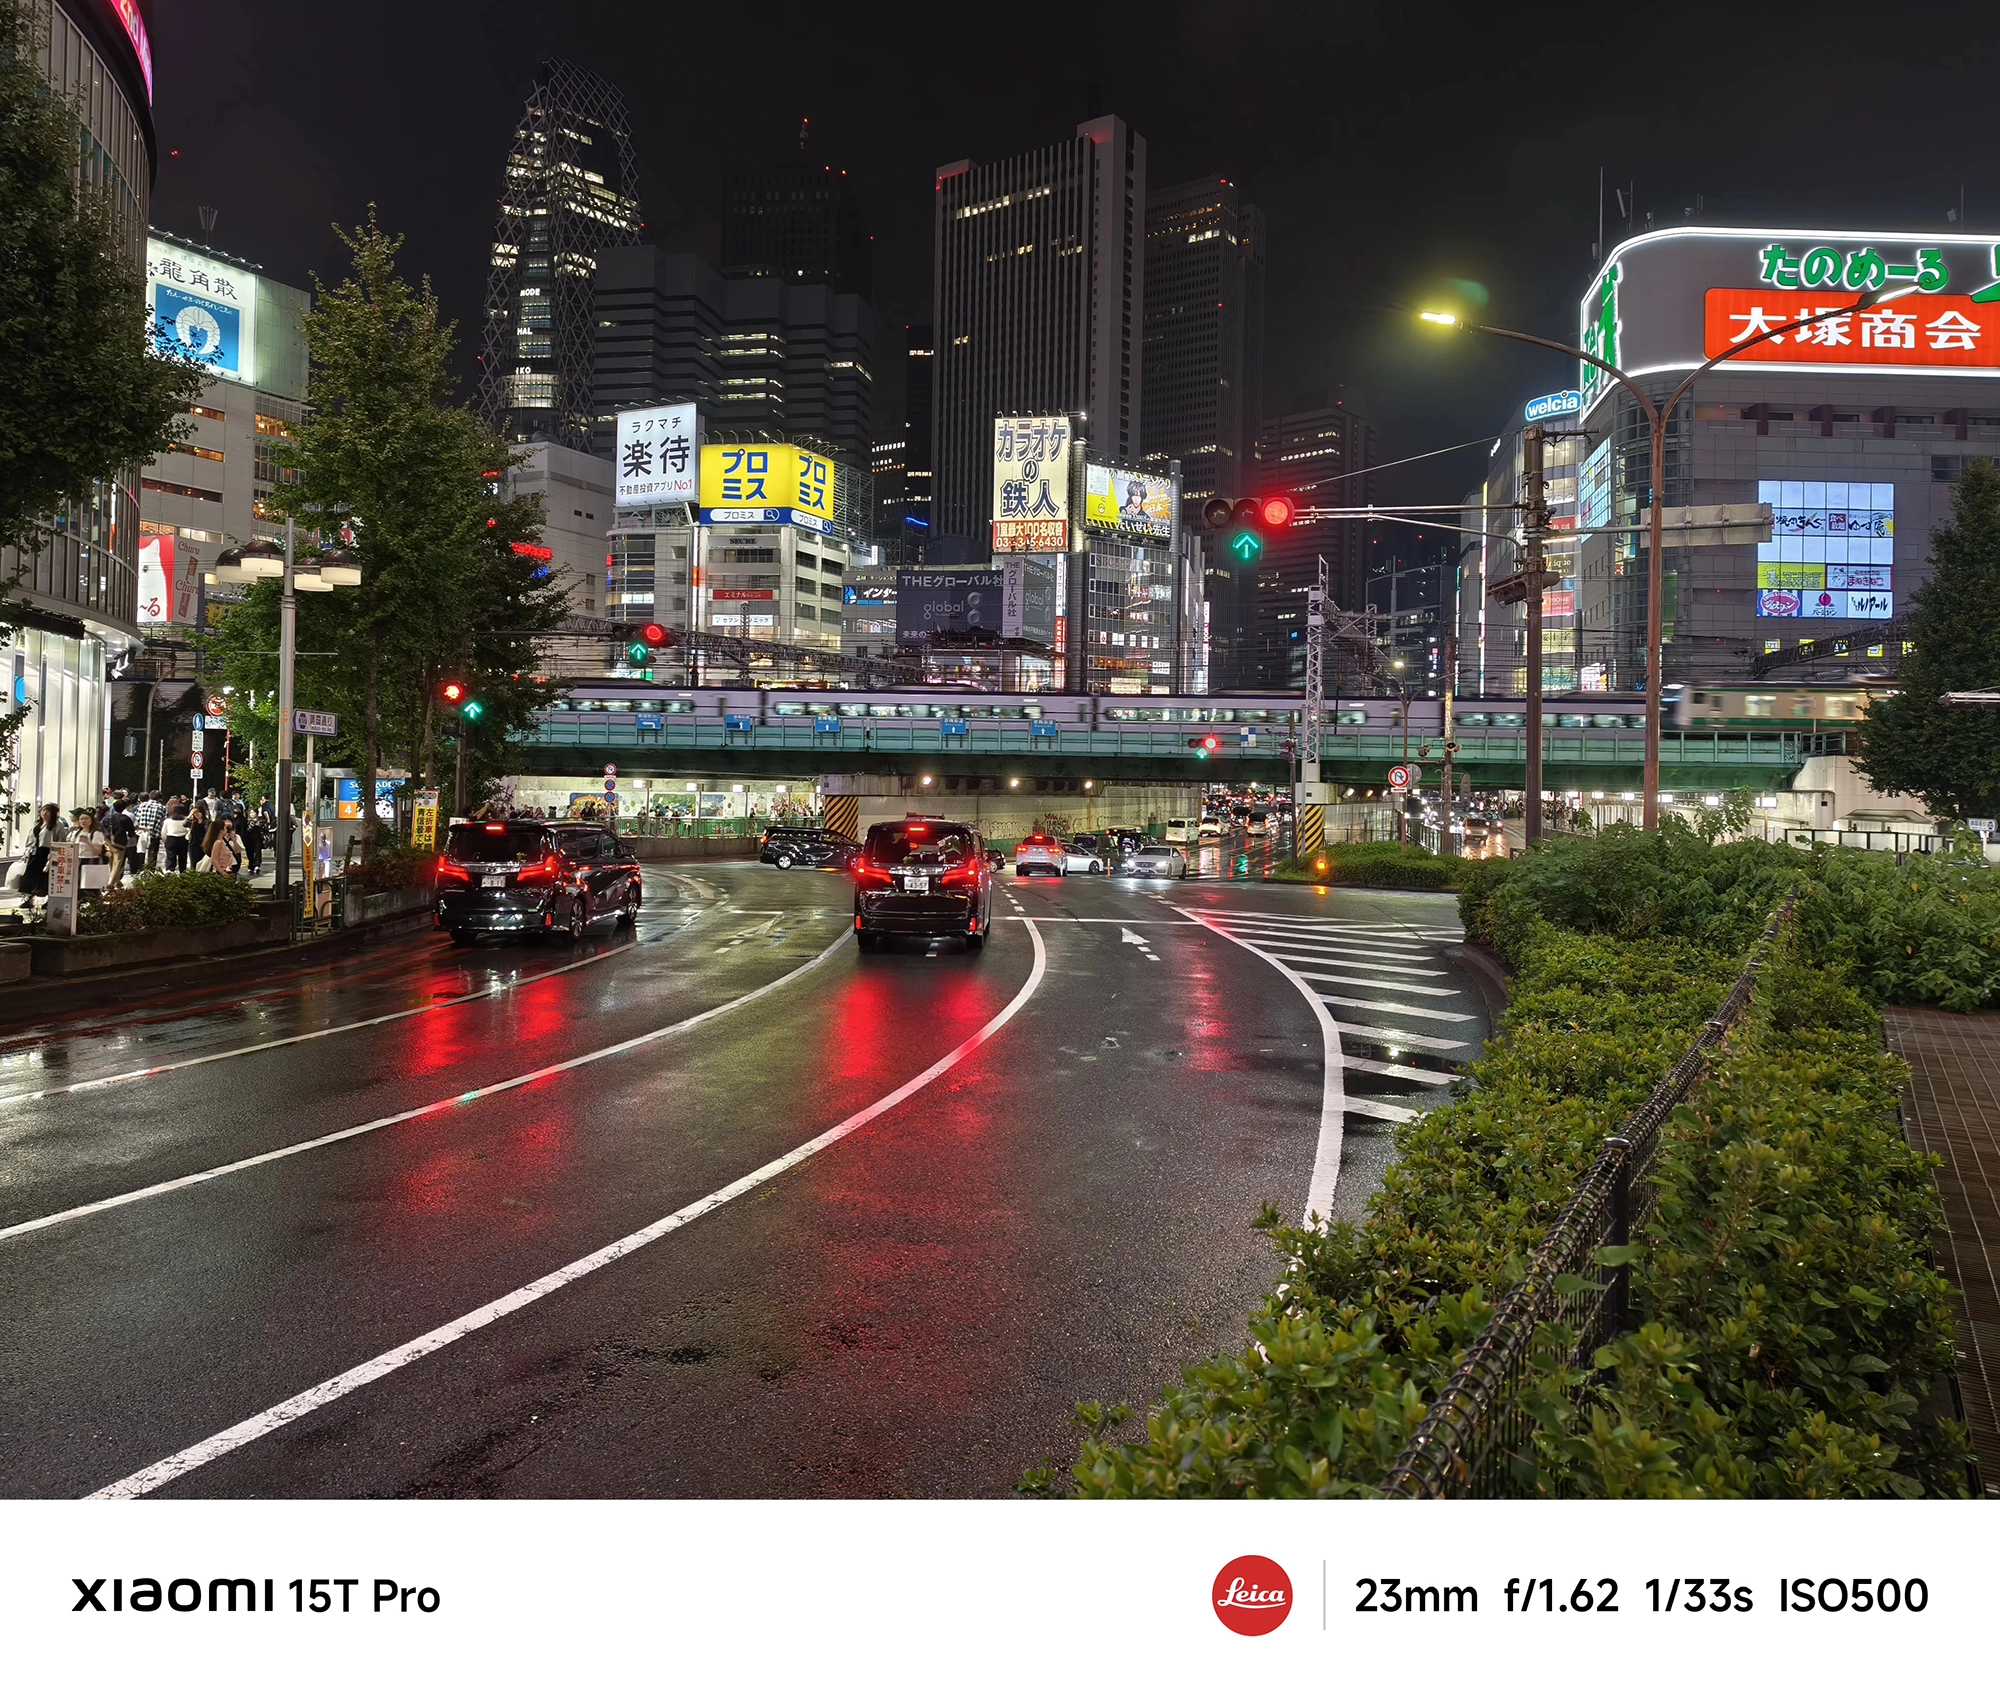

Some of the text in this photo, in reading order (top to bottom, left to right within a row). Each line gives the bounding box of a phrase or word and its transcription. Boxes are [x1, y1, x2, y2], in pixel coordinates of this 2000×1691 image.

[159, 257, 237, 300] 龍角散
[1763, 244, 1949, 291] たのめーる
[520, 288, 540, 297] MODE
[517, 327, 533, 335] HAL
[1729, 307, 1981, 350] 大塚商会
[1528, 392, 1578, 418] welcia
[632, 416, 682, 434] ラクマチ
[996, 419, 1067, 462] カラオケ
[622, 434, 691, 478] 楽待
[721, 448, 768, 474] プロ
[798, 455, 826, 485] プロ
[1022, 457, 1039, 483] の
[721, 478, 768, 500] ミス
[798, 481, 826, 511] ミス
[1000, 479, 1060, 518] 鉄人
[723, 511, 755, 520] プロミス
[799, 514, 818, 527] プロミス
[178, 541, 200, 555] Churu
[902, 575, 1004, 588] THEグローバル社
[1006, 561, 1021, 617] THEグローバル社
[1848, 576, 1884, 586] まねきねこ
[723, 616, 769, 624] セブンリニック
[923, 600, 964, 620] global
[1812, 609, 1837, 617] バーミヤン
[344, 804, 352, 814] 4
[426, 808, 434, 842] 左折車は
